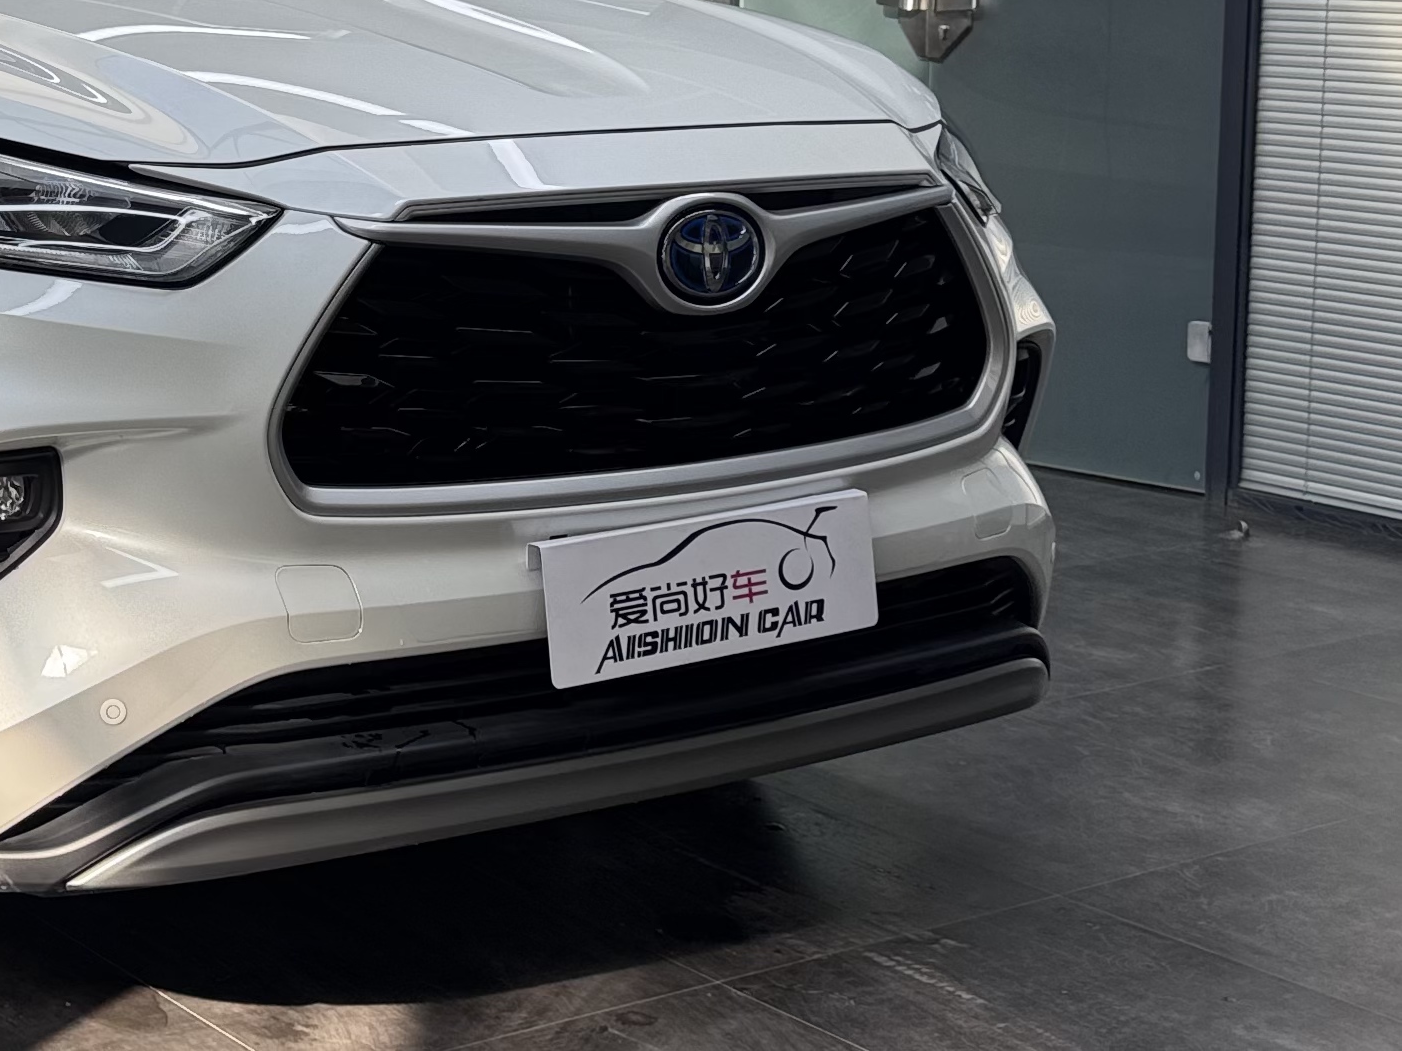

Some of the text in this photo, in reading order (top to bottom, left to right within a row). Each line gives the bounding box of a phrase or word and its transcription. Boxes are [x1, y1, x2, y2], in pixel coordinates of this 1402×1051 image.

[609, 568, 769, 630] 爱尚好车
[594, 598, 827, 676] AISHION CAR
